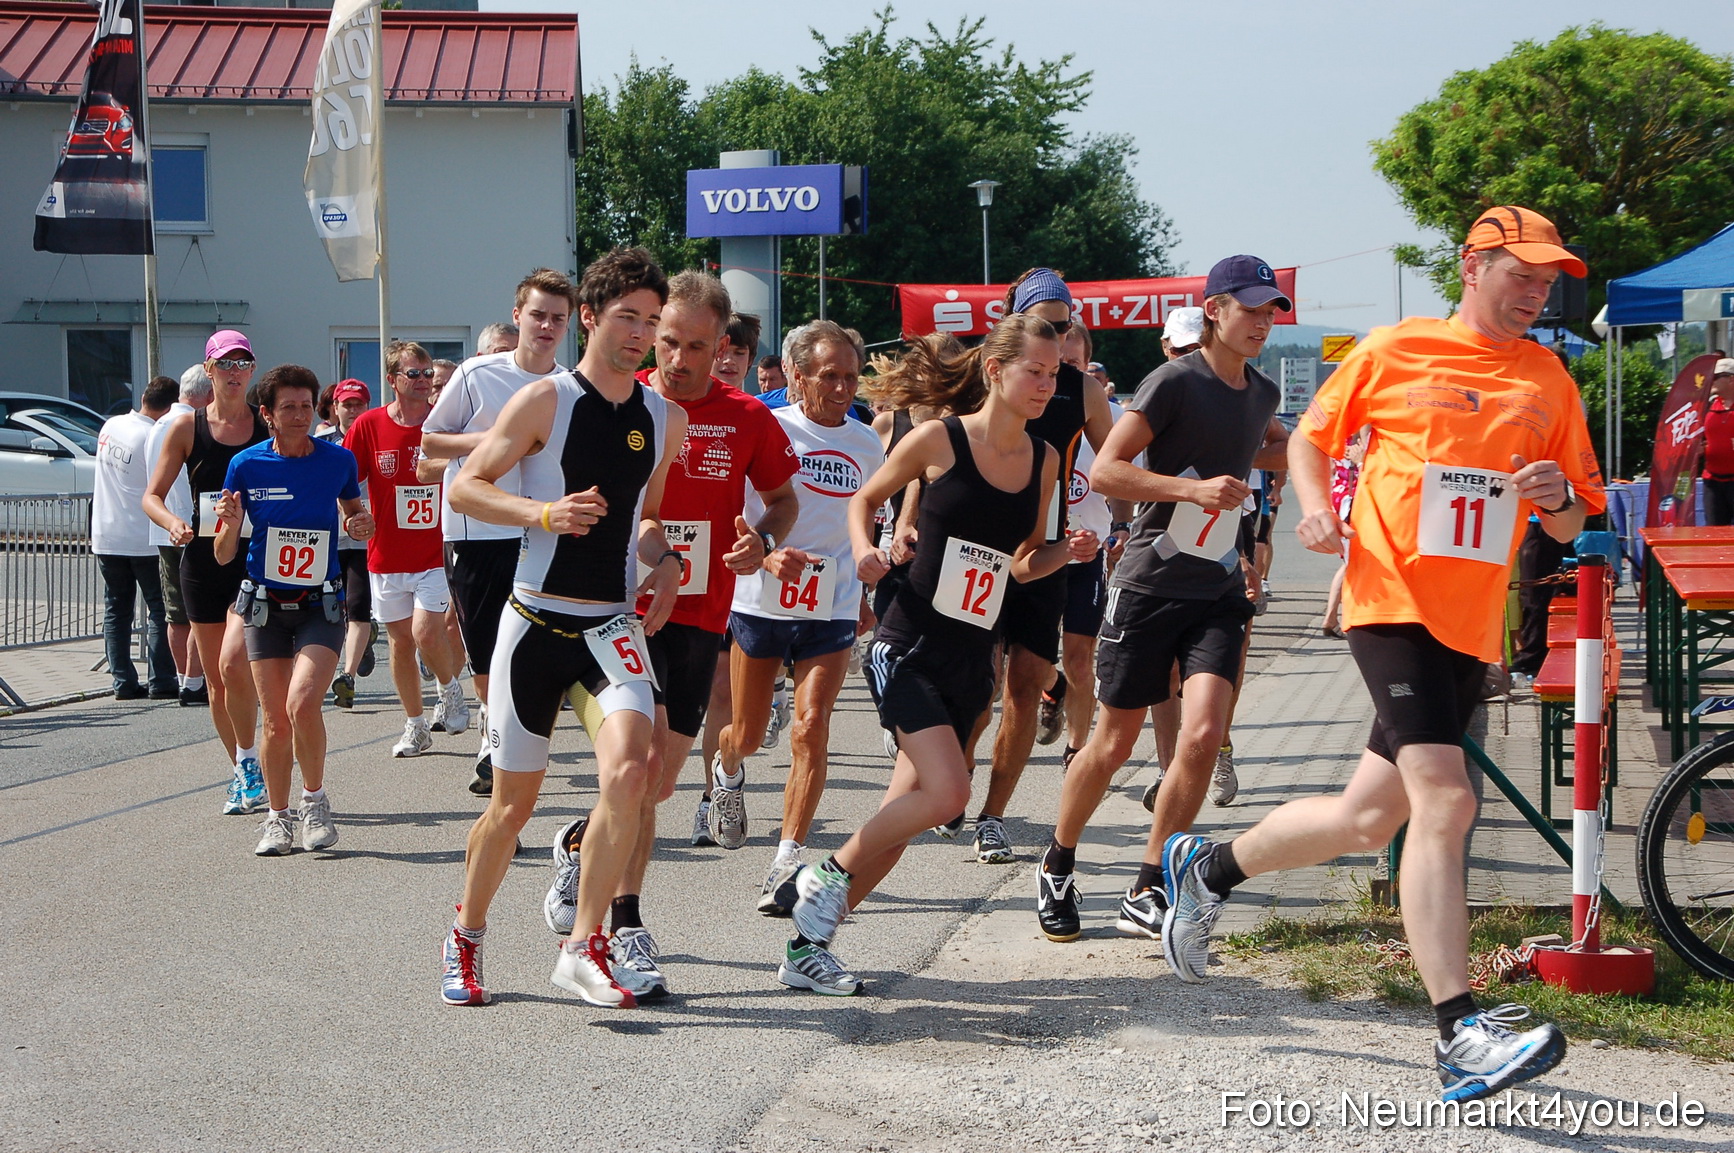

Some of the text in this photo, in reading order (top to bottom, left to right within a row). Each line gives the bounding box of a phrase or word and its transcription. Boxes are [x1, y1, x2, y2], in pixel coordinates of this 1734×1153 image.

[701, 186, 820, 213] VOLVO
[797, 456, 851, 475] RHART
[813, 472, 859, 490] JÄNIG
[1440, 472, 1487, 486] MEYER
[1440, 483, 1487, 495] WERBUNG
[407, 499, 434, 525] 25
[664, 524, 682, 534] YER
[1450, 496, 1486, 549] 11
[278, 530, 308, 539] MEYER
[278, 537, 308, 545] WERBUNG
[277, 545, 315, 579] 92
[959, 553, 993, 570] WERBUNG
[960, 544, 994, 563] MEYER
[779, 575, 819, 612] 64
[961, 567, 995, 617] 12
[597, 614, 629, 639] MEYE
[611, 636, 644, 675] 5
